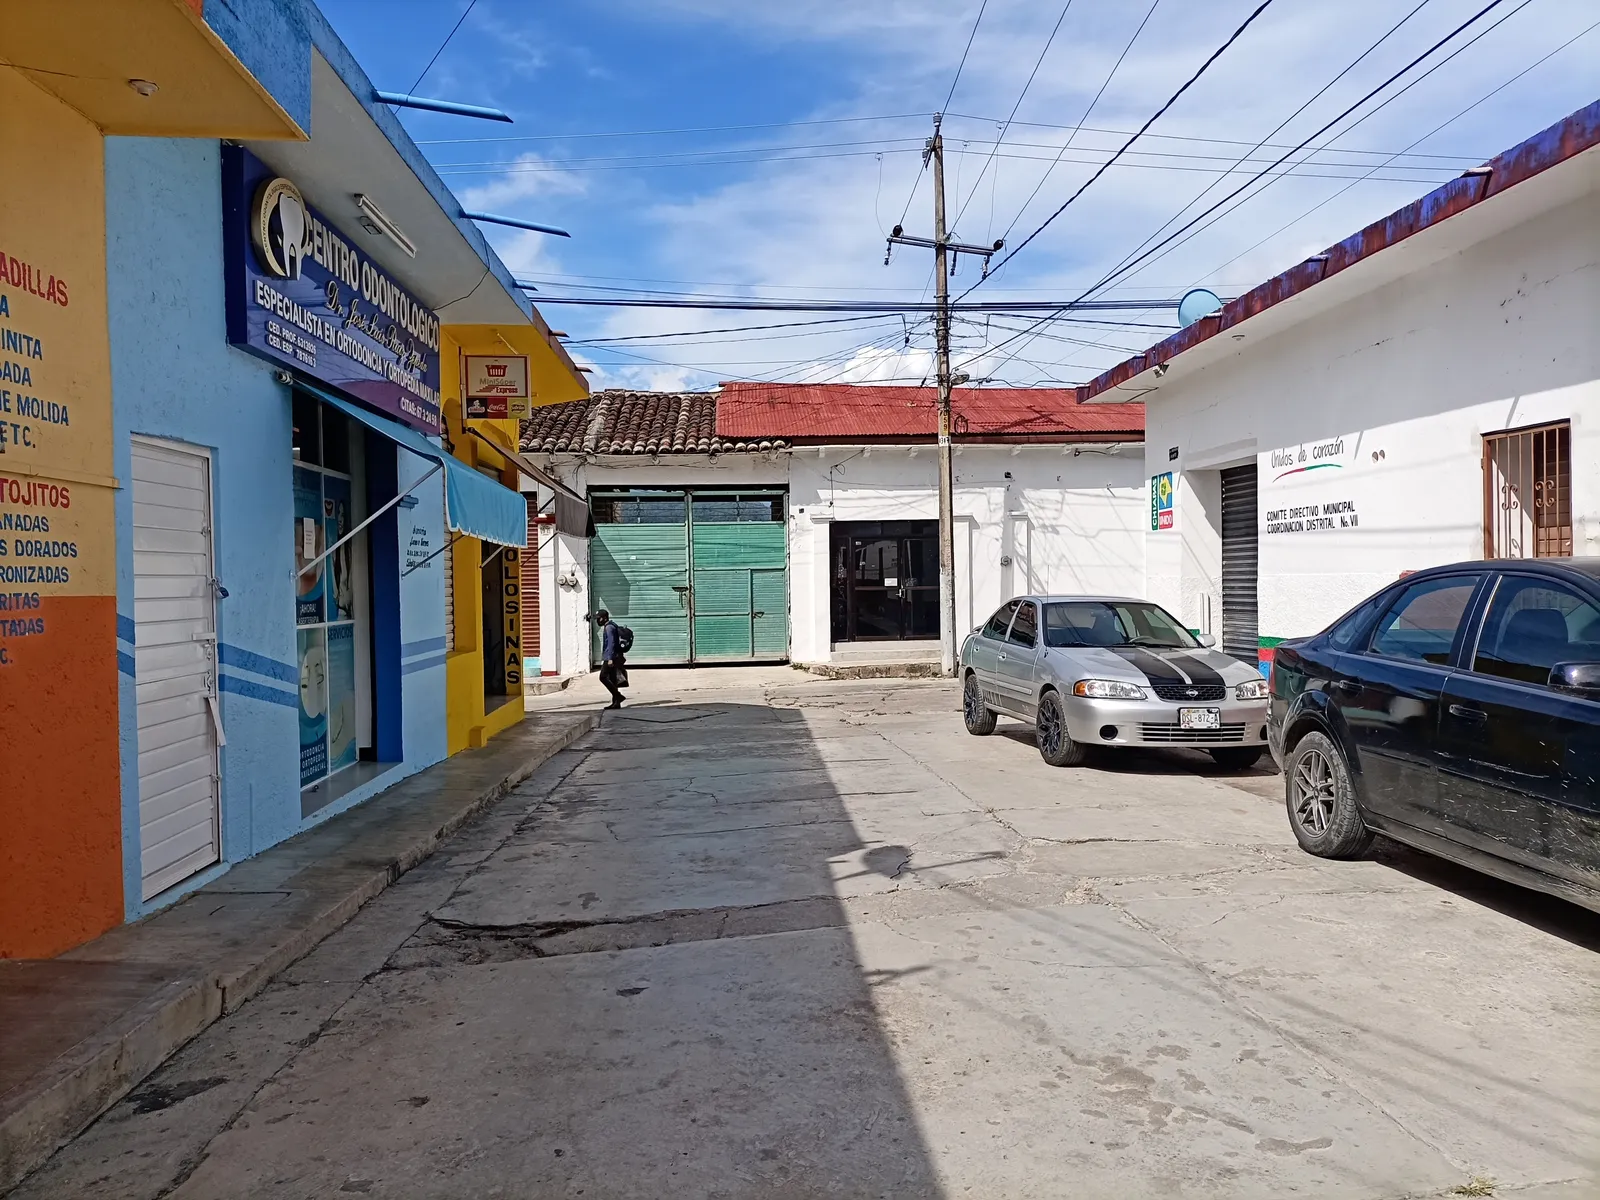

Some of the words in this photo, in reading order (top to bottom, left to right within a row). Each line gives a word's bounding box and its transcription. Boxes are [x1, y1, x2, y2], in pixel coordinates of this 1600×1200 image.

[305, 210, 360, 291] CENTRO
[362, 261, 440, 353] ODONTOLOGICO
[256, 280, 323, 340] ESPECIALISTA
[324, 321, 336, 347] EN
[337, 330, 383, 375] ORTODONCIA
[383, 357, 389, 378] Y
[388, 361, 420, 396] ORTOPEDIA
[268, 320, 282, 337] CED.
[268, 334, 282, 350] CED.
[0, 360, 32, 387] ADA
[17, 393, 69, 426] MOLIDA
[1271, 448, 1294, 469] Unidos
[1298, 443, 1307, 463] de
[1313, 436, 1344, 460] corazón
[1267, 509, 1288, 522] COMITE
[1290, 505, 1319, 519] DIRECTIVO
[1323, 500, 1356, 516] MUNICIPAL
[1267, 523, 1304, 534] COORDINACION
[1306, 517, 1336, 531] DISTRITAL
[15, 539, 78, 558] DORADOS
